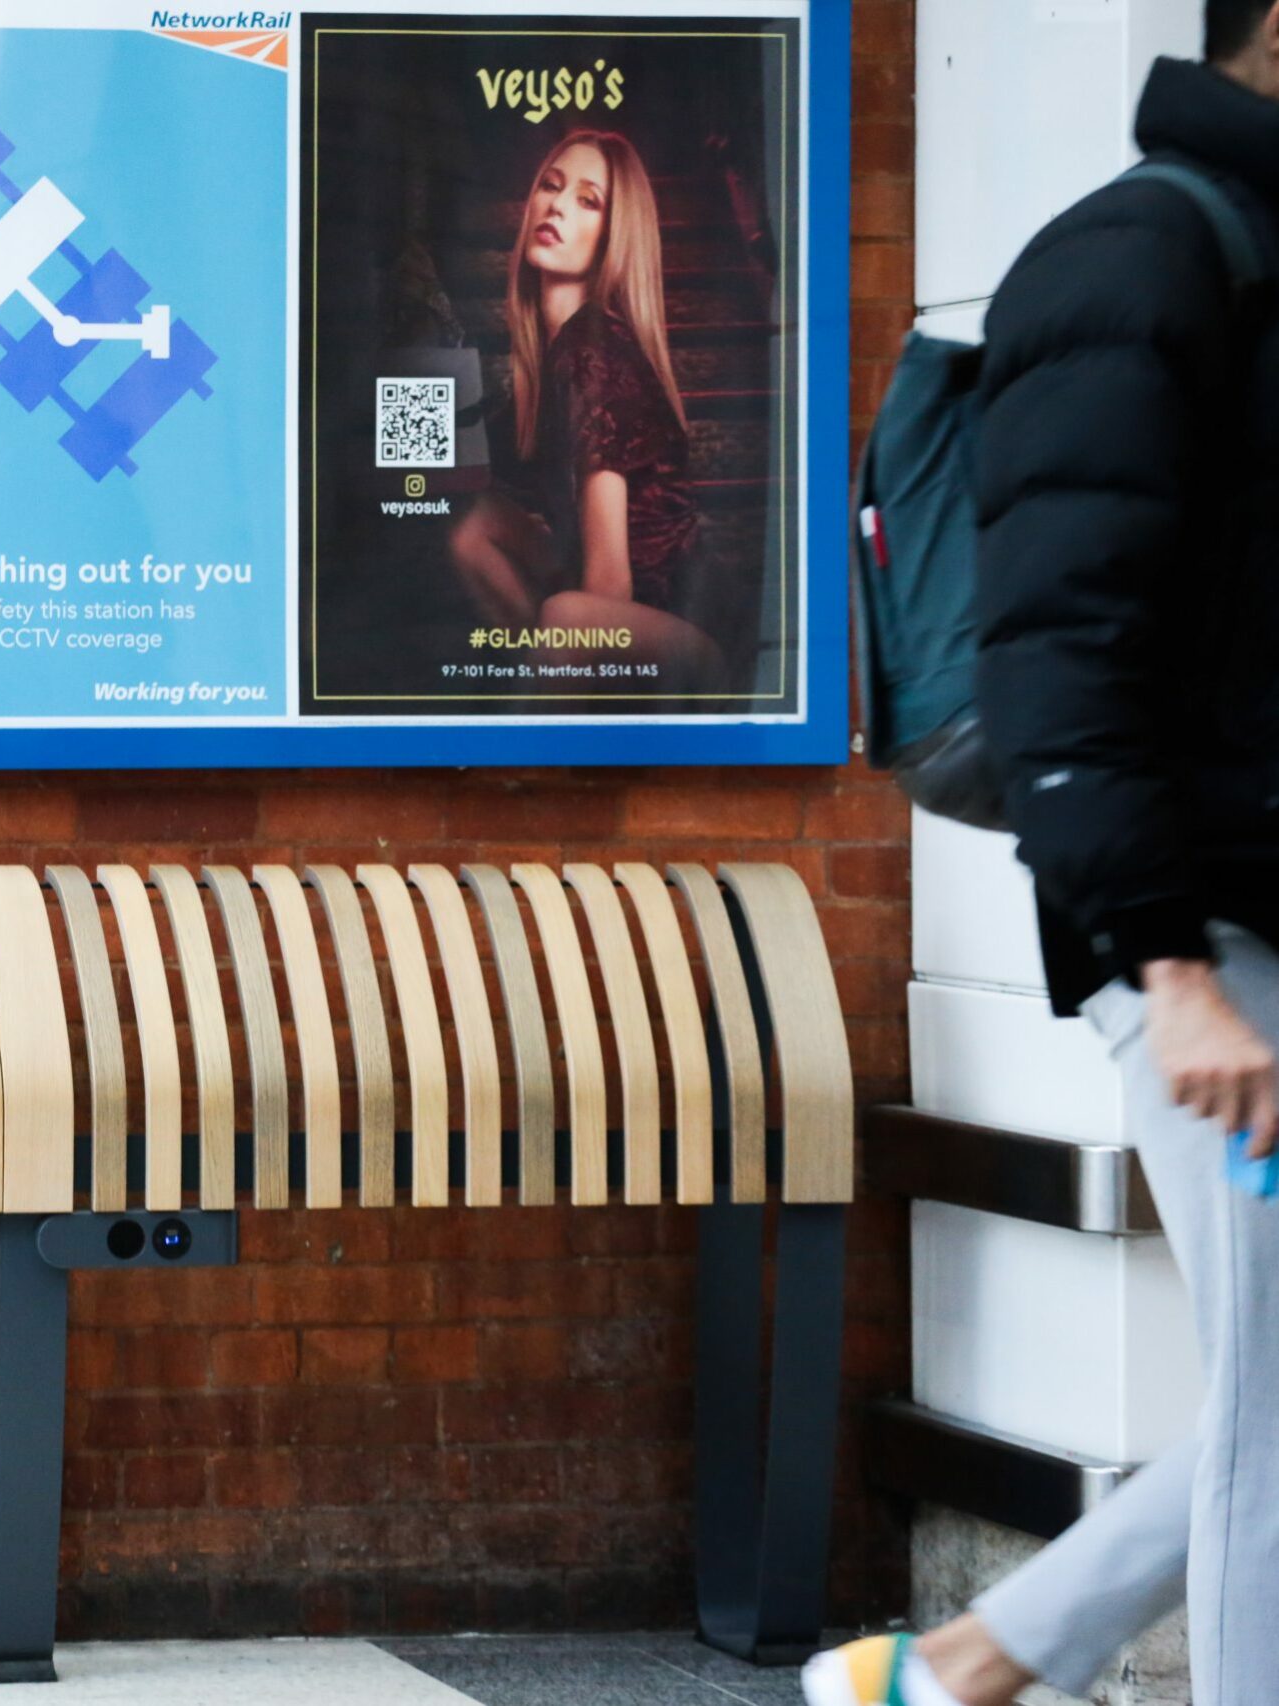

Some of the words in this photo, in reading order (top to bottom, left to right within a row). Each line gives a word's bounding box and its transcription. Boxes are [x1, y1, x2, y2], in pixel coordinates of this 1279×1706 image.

[380, 499, 451, 518] veysosuk
[79, 558, 131, 583] out
[140, 555, 185, 583] for
[196, 563, 251, 590] you
[41, 600, 77, 619] this
[84, 602, 153, 619] station
[160, 600, 195, 619] has
[66, 632, 162, 653] coverage
[469, 627, 632, 649] #GLAMDINING
[441, 664, 483, 677] 97-101
[487, 664, 515, 677] Fore
[599, 664, 632, 677] SG14
[636, 664, 659, 677] 1AS
[94, 682, 184, 705] Working
[188, 682, 222, 701] for
